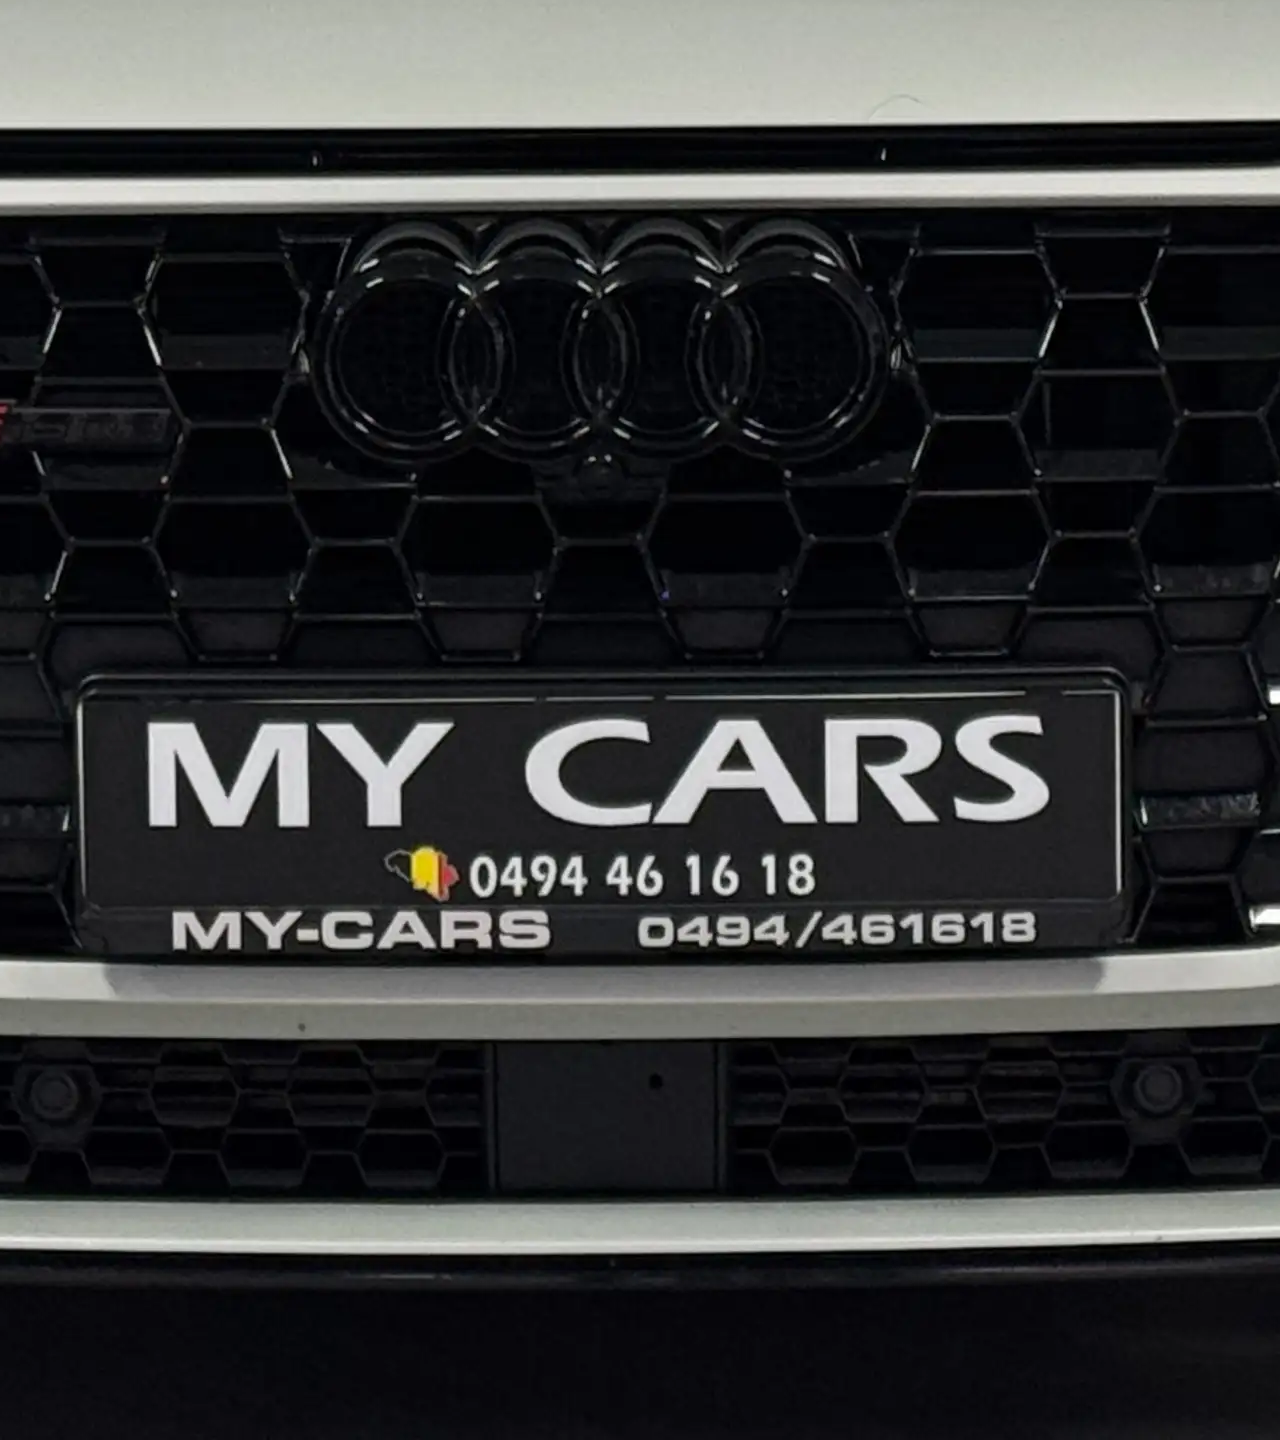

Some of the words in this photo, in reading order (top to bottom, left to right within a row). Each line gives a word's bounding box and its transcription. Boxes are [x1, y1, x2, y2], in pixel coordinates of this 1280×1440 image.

[147, 721, 455, 828] MY
[524, 715, 1051, 827] CARS
[469, 854, 588, 899] 0494
[606, 854, 664, 897] 46
[685, 853, 740, 896] 16
[761, 852, 816, 896] 18
[171, 910, 551, 951] MY-CARS
[637, 910, 1037, 949] 0494/461618
